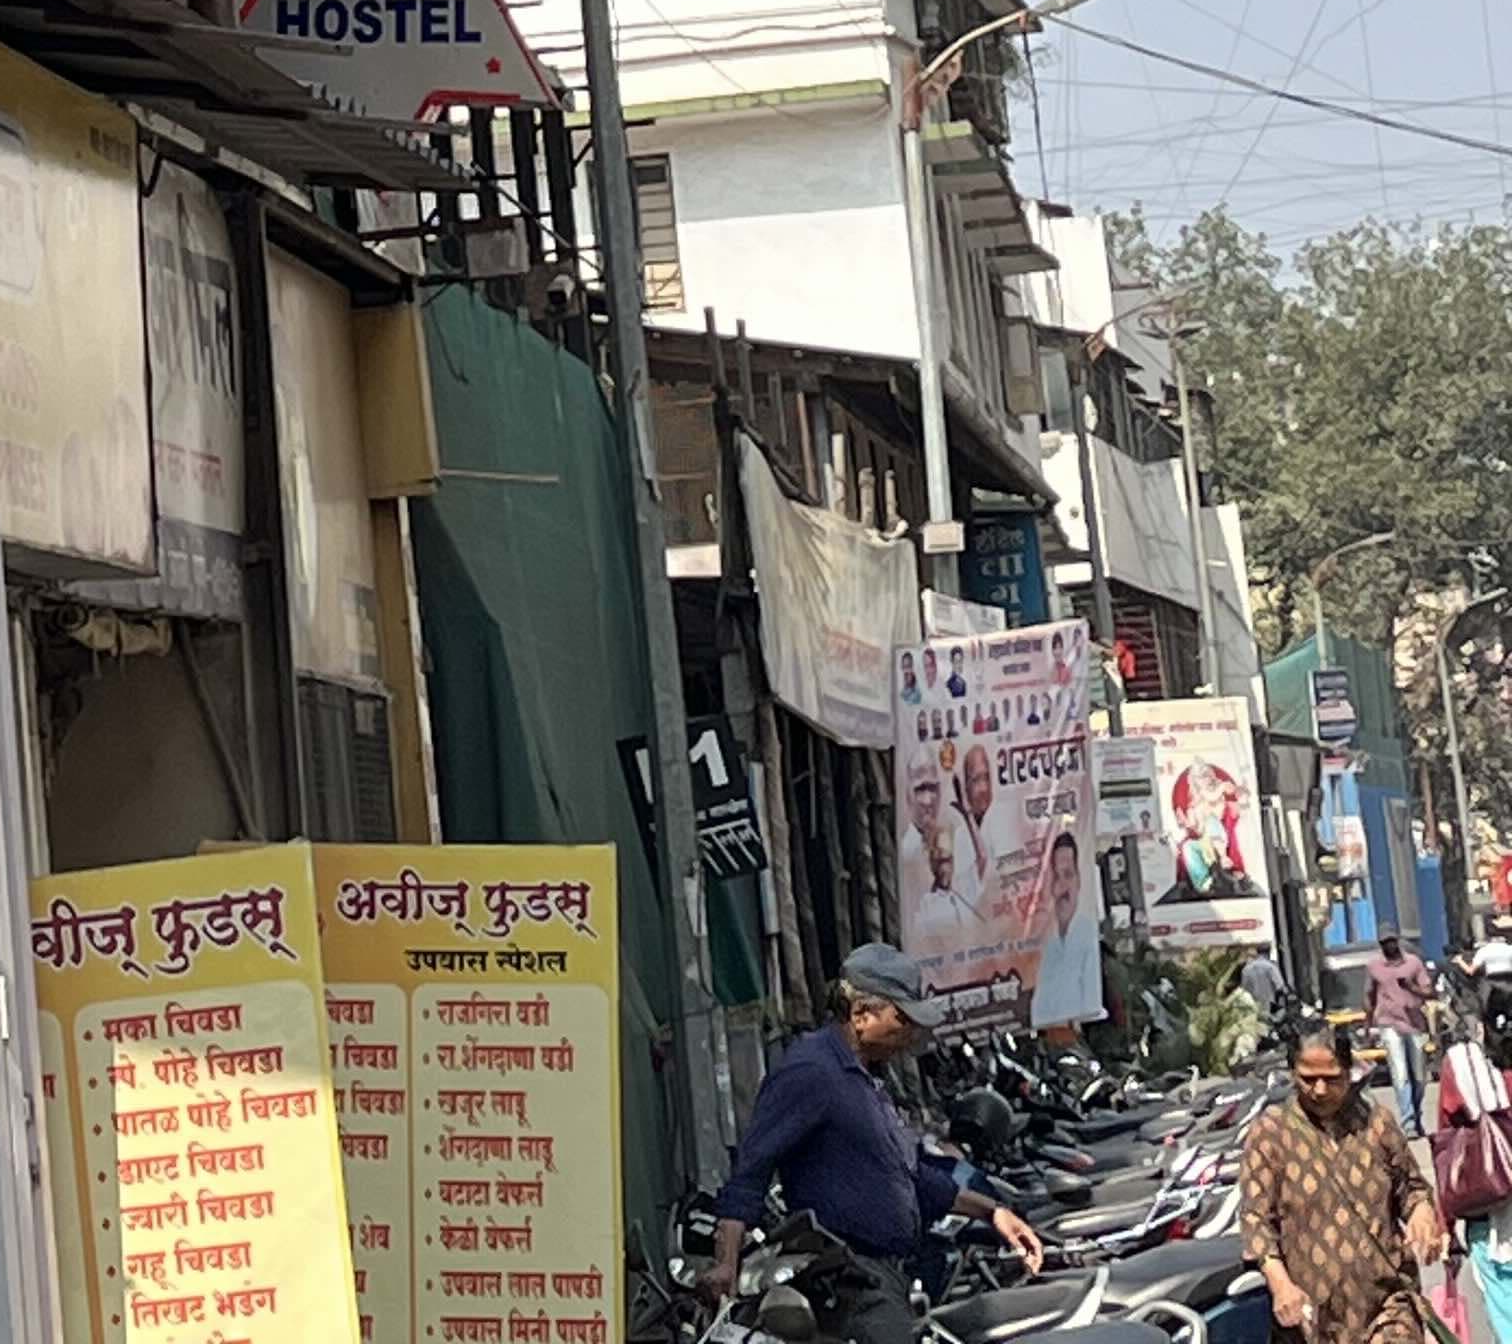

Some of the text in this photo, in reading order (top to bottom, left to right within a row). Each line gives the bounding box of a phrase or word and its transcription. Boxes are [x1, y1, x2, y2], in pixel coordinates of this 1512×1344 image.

[31, 898, 150, 979] वीज्
[405, 948, 488, 973] उपवास
[102, 1002, 242, 1044] मका चिवडा
[153, 1048, 198, 1089] पोहे
[205, 1044, 283, 1081] चिवडा
[343, 1035, 398, 1070] चिवडा
[111, 1088, 318, 1137] पातळ पोहे चिवडा
[351, 1080, 406, 1115] चिवडा
[117, 1141, 265, 1186] डाएट चिवडा
[196, 1188, 275, 1225] चिवडा
[174, 1239, 252, 1275] चिवडा
[130, 1291, 206, 1329] तिखट
